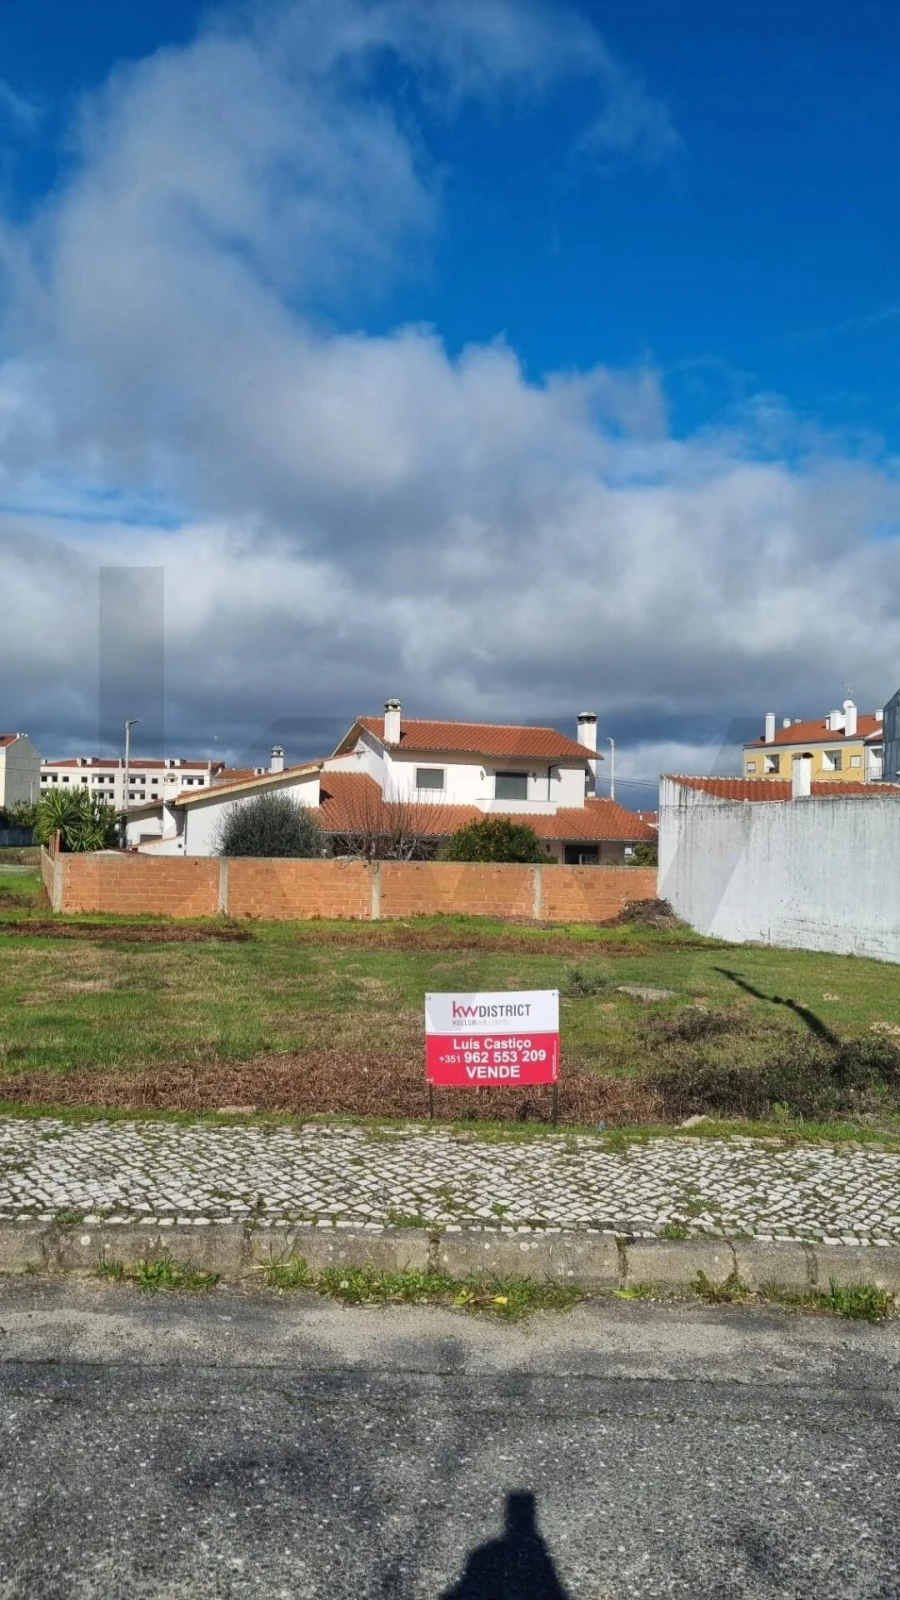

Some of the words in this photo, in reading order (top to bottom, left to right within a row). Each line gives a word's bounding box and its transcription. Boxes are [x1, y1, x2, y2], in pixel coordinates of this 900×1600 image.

[484, 1037, 532, 1051] Castiço
[439, 1055, 461, 1063] +351
[464, 1052, 489, 1063] 962
[493, 1051, 517, 1062] 553
[522, 1049, 546, 1061] 209
[466, 1066, 520, 1078] VENDE
